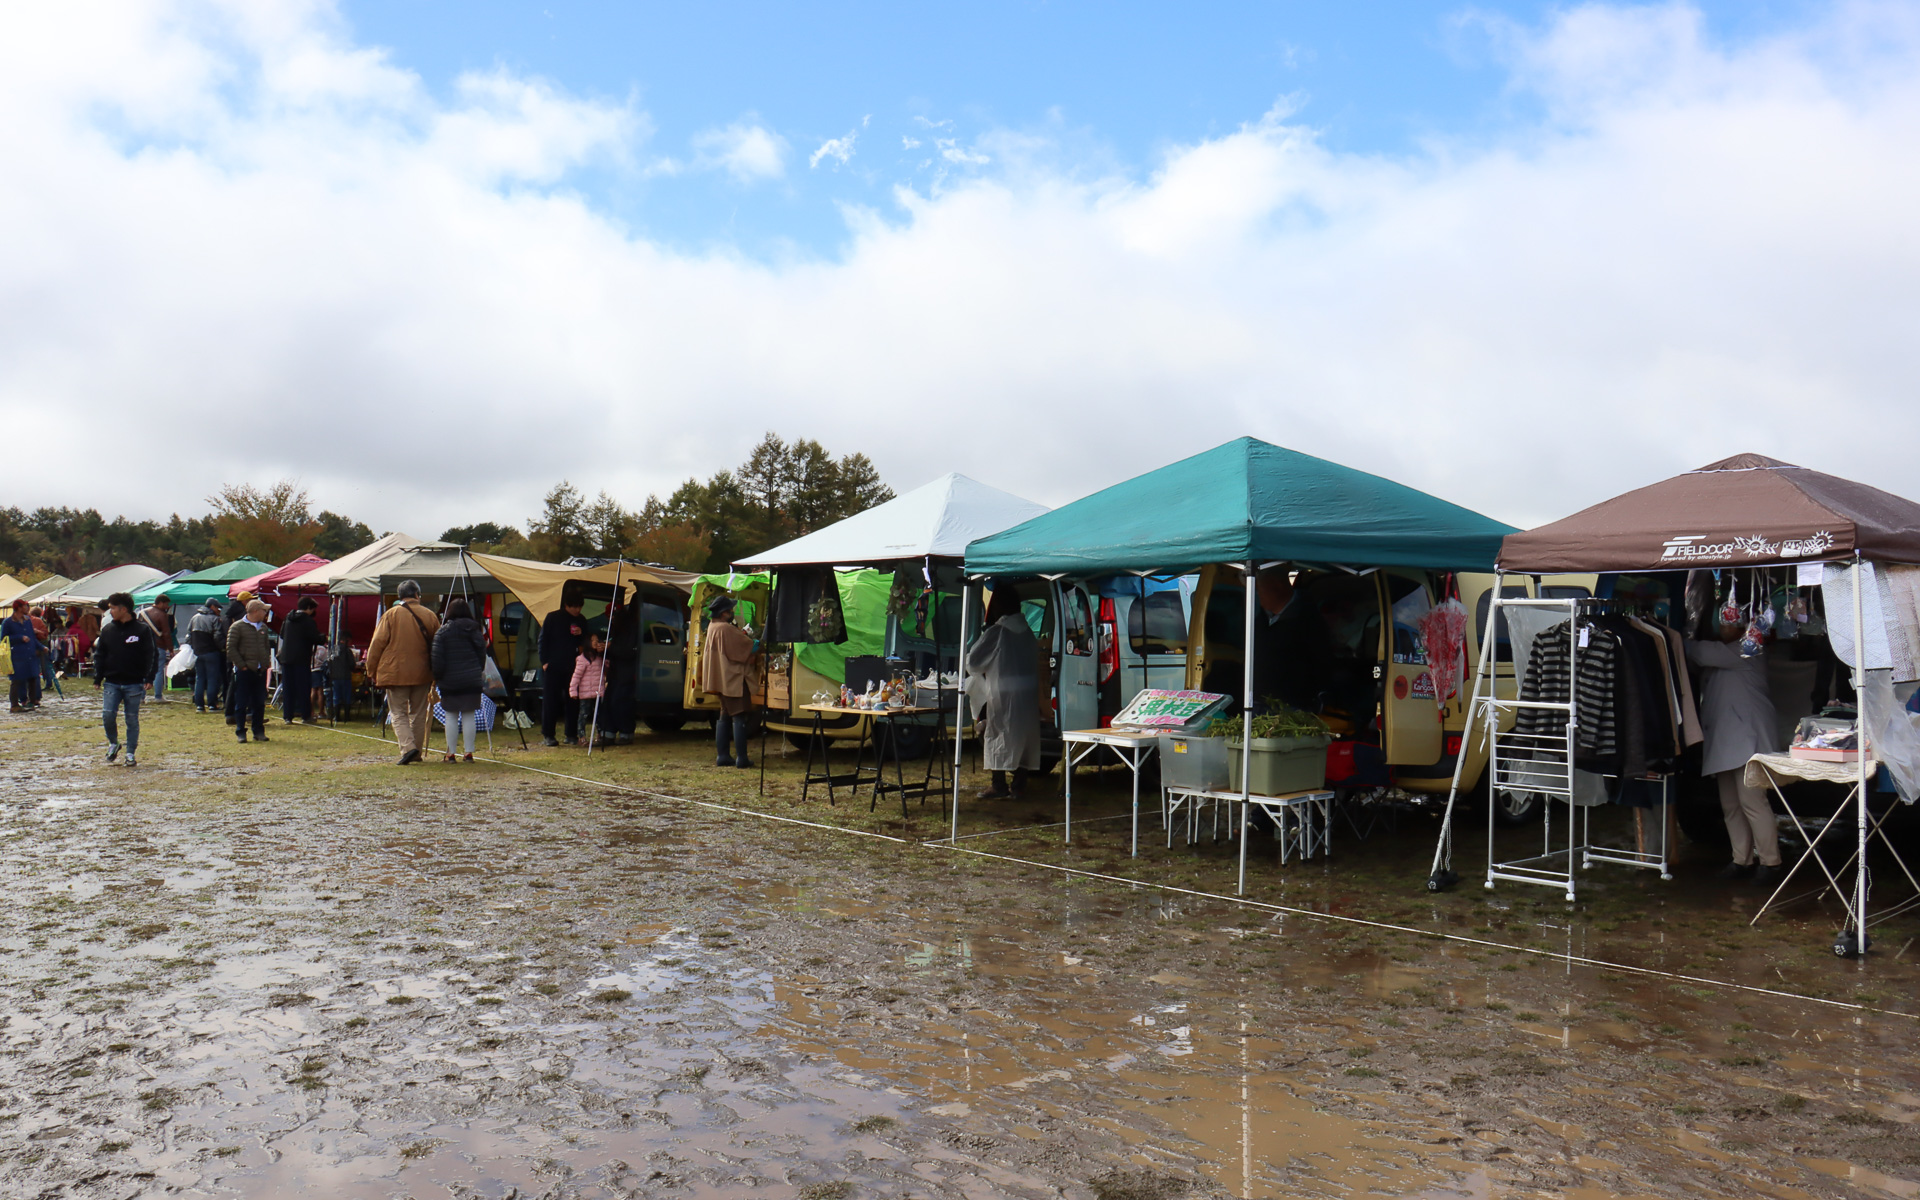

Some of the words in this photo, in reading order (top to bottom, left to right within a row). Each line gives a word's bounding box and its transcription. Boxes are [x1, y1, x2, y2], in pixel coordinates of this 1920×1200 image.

[1677, 543, 1734, 556] FIELDOOR
[1413, 683, 1434, 692] Kangoo
[1139, 699, 1202, 717] 黒枝豆
